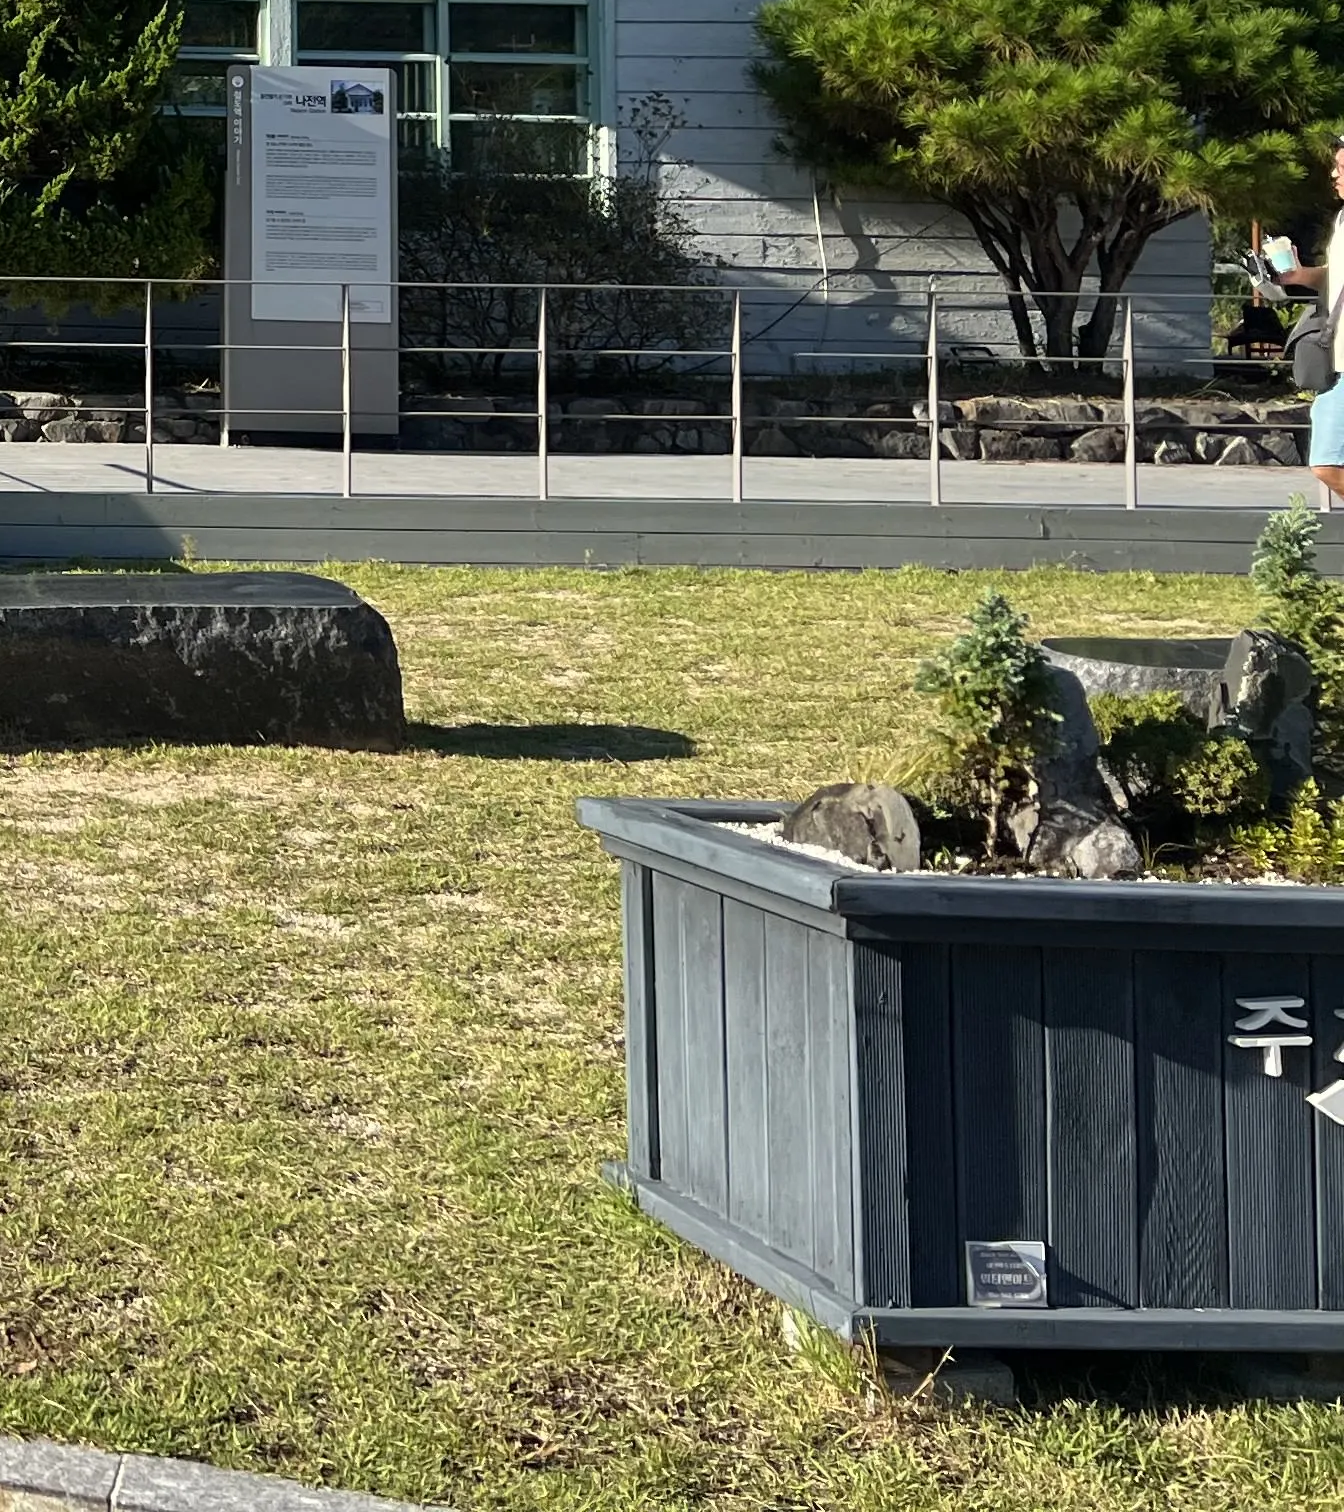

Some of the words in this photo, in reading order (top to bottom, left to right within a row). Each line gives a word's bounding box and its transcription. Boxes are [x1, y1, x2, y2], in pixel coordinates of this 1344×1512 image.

[295, 95, 327, 107] 나전역
[233, 118, 243, 145] 이야기
[1228, 995, 1344, 1078] 주
